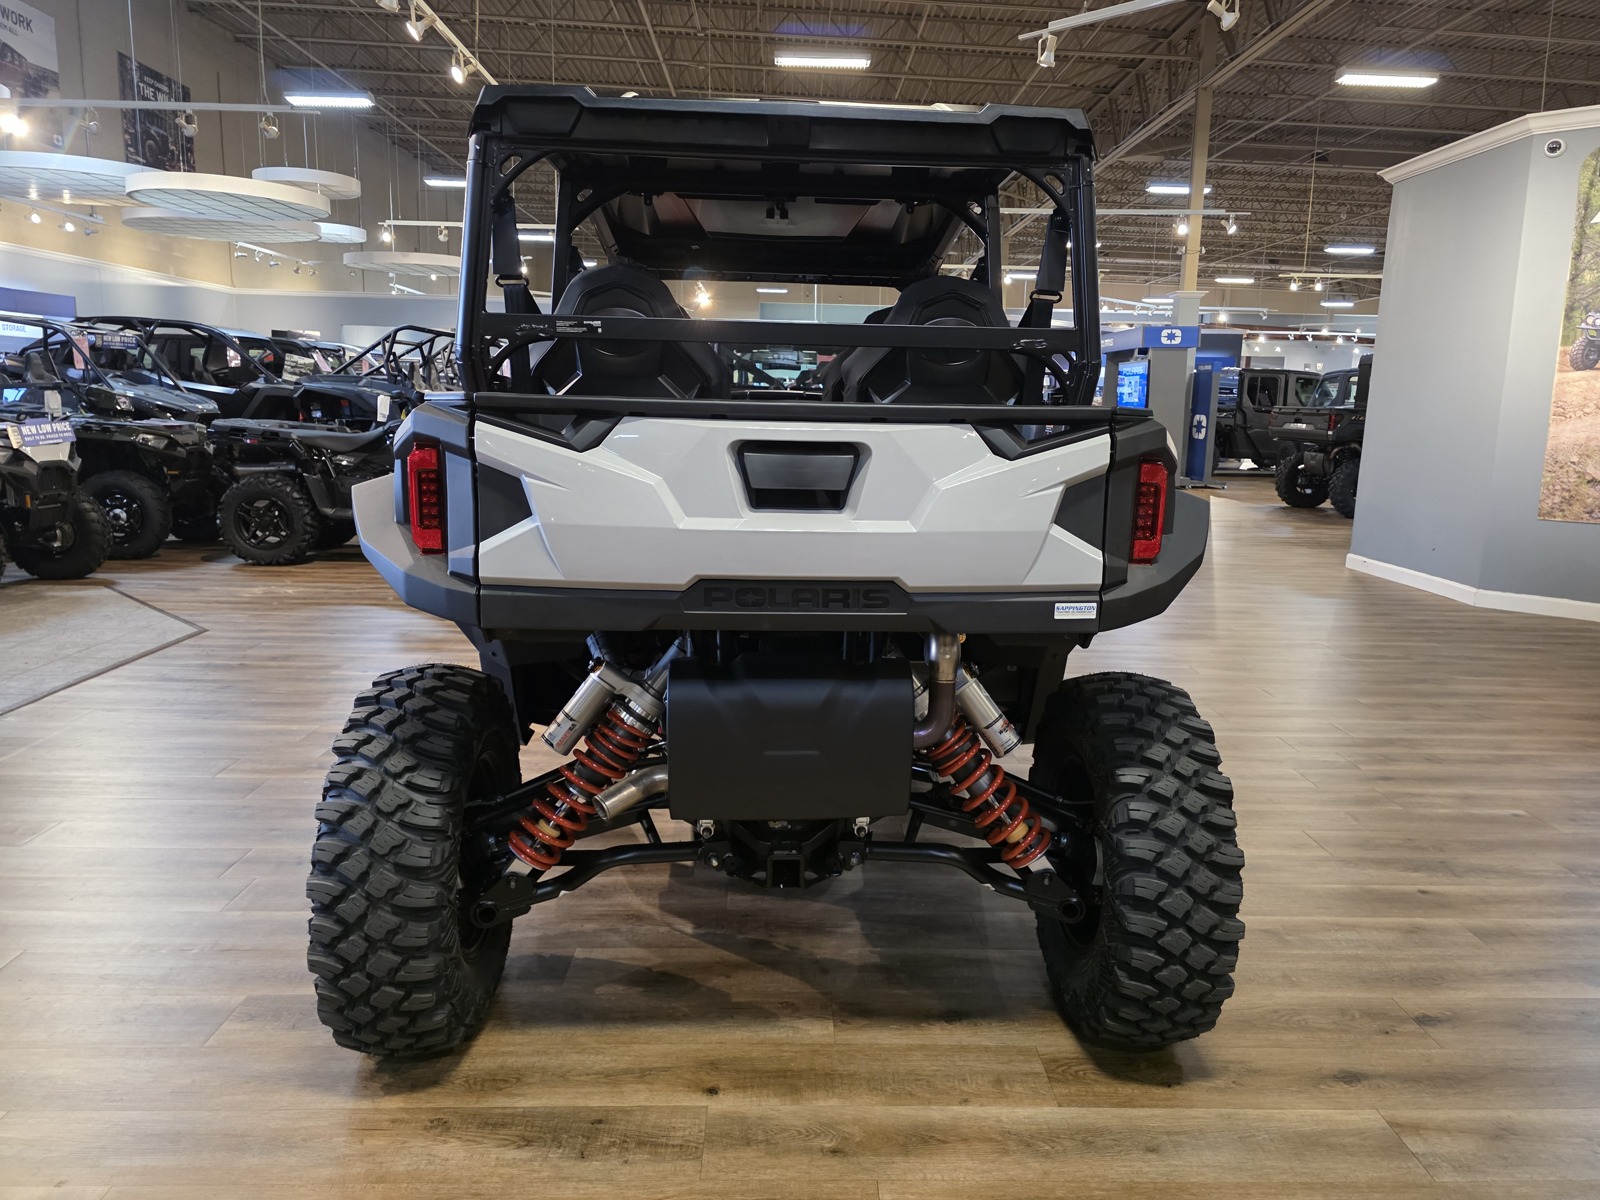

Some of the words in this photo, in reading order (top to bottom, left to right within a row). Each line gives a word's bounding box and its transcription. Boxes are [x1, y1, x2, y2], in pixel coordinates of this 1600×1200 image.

[0, 4, 34, 33] WORK
[139, 82, 155, 100] THE
[2, 323, 26, 332] STORAGE
[1123, 366, 1143, 375] POLARIS
[21, 425, 37, 435] NEW
[37, 424, 51, 434] LOW
[52, 422, 71, 432] PRICE
[704, 587, 889, 608] POLARIS
